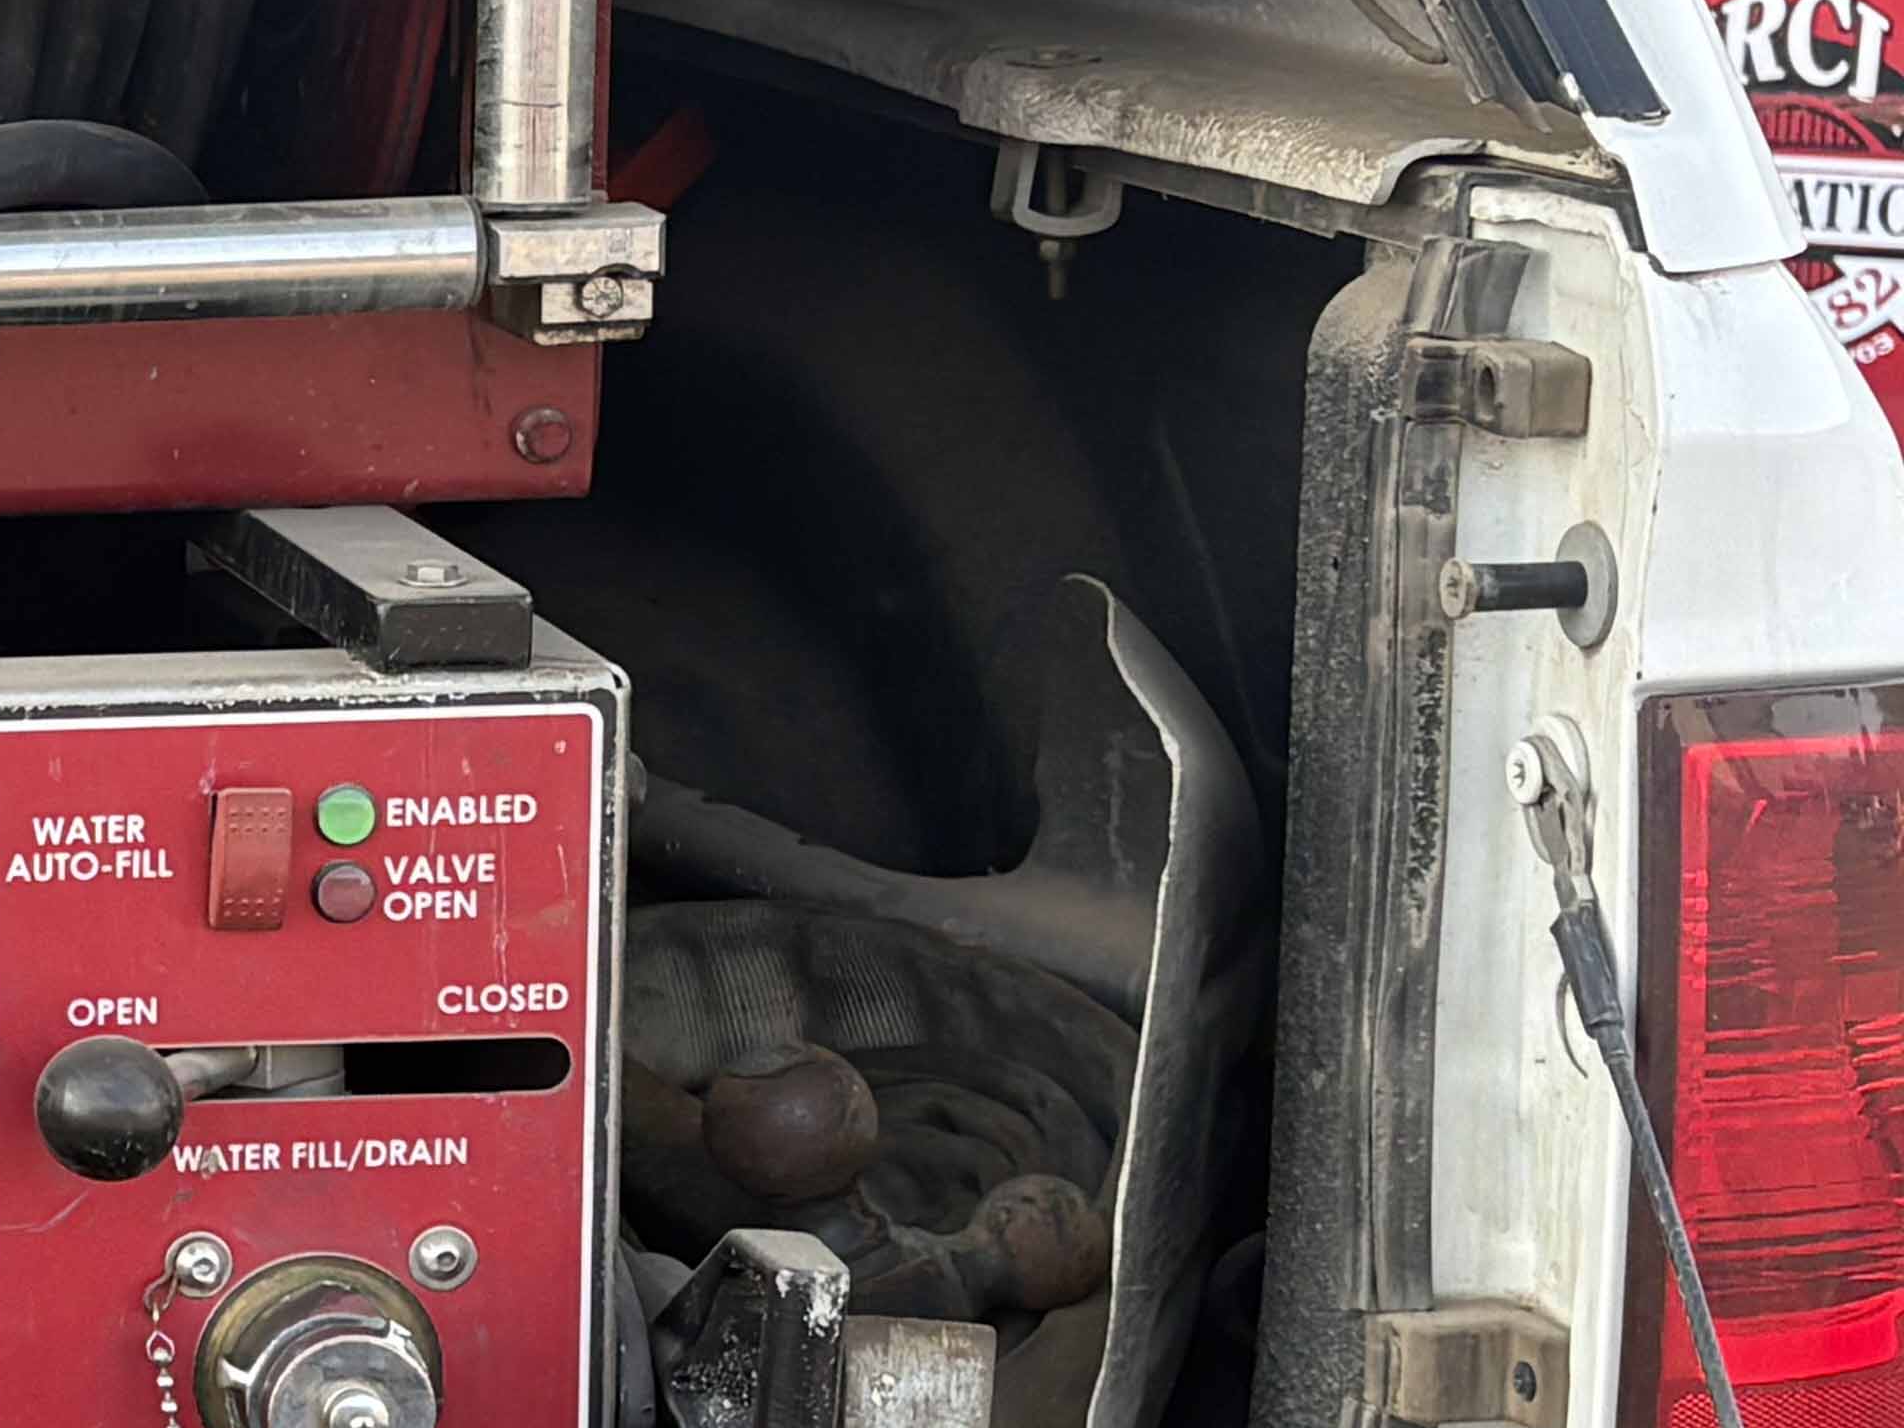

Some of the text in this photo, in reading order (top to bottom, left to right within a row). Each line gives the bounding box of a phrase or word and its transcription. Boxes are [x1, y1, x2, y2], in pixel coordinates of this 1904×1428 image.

[386, 795, 537, 828] ENABLED
[32, 814, 145, 846] WATER
[5, 849, 173, 883] AUTO-FILL
[384, 853, 496, 885] VALVE
[383, 891, 478, 921] OPEN
[67, 997, 158, 1028] OPEN
[437, 983, 569, 1015] CLOSED
[173, 1137, 468, 1173] WATER FILL/DRAIN
